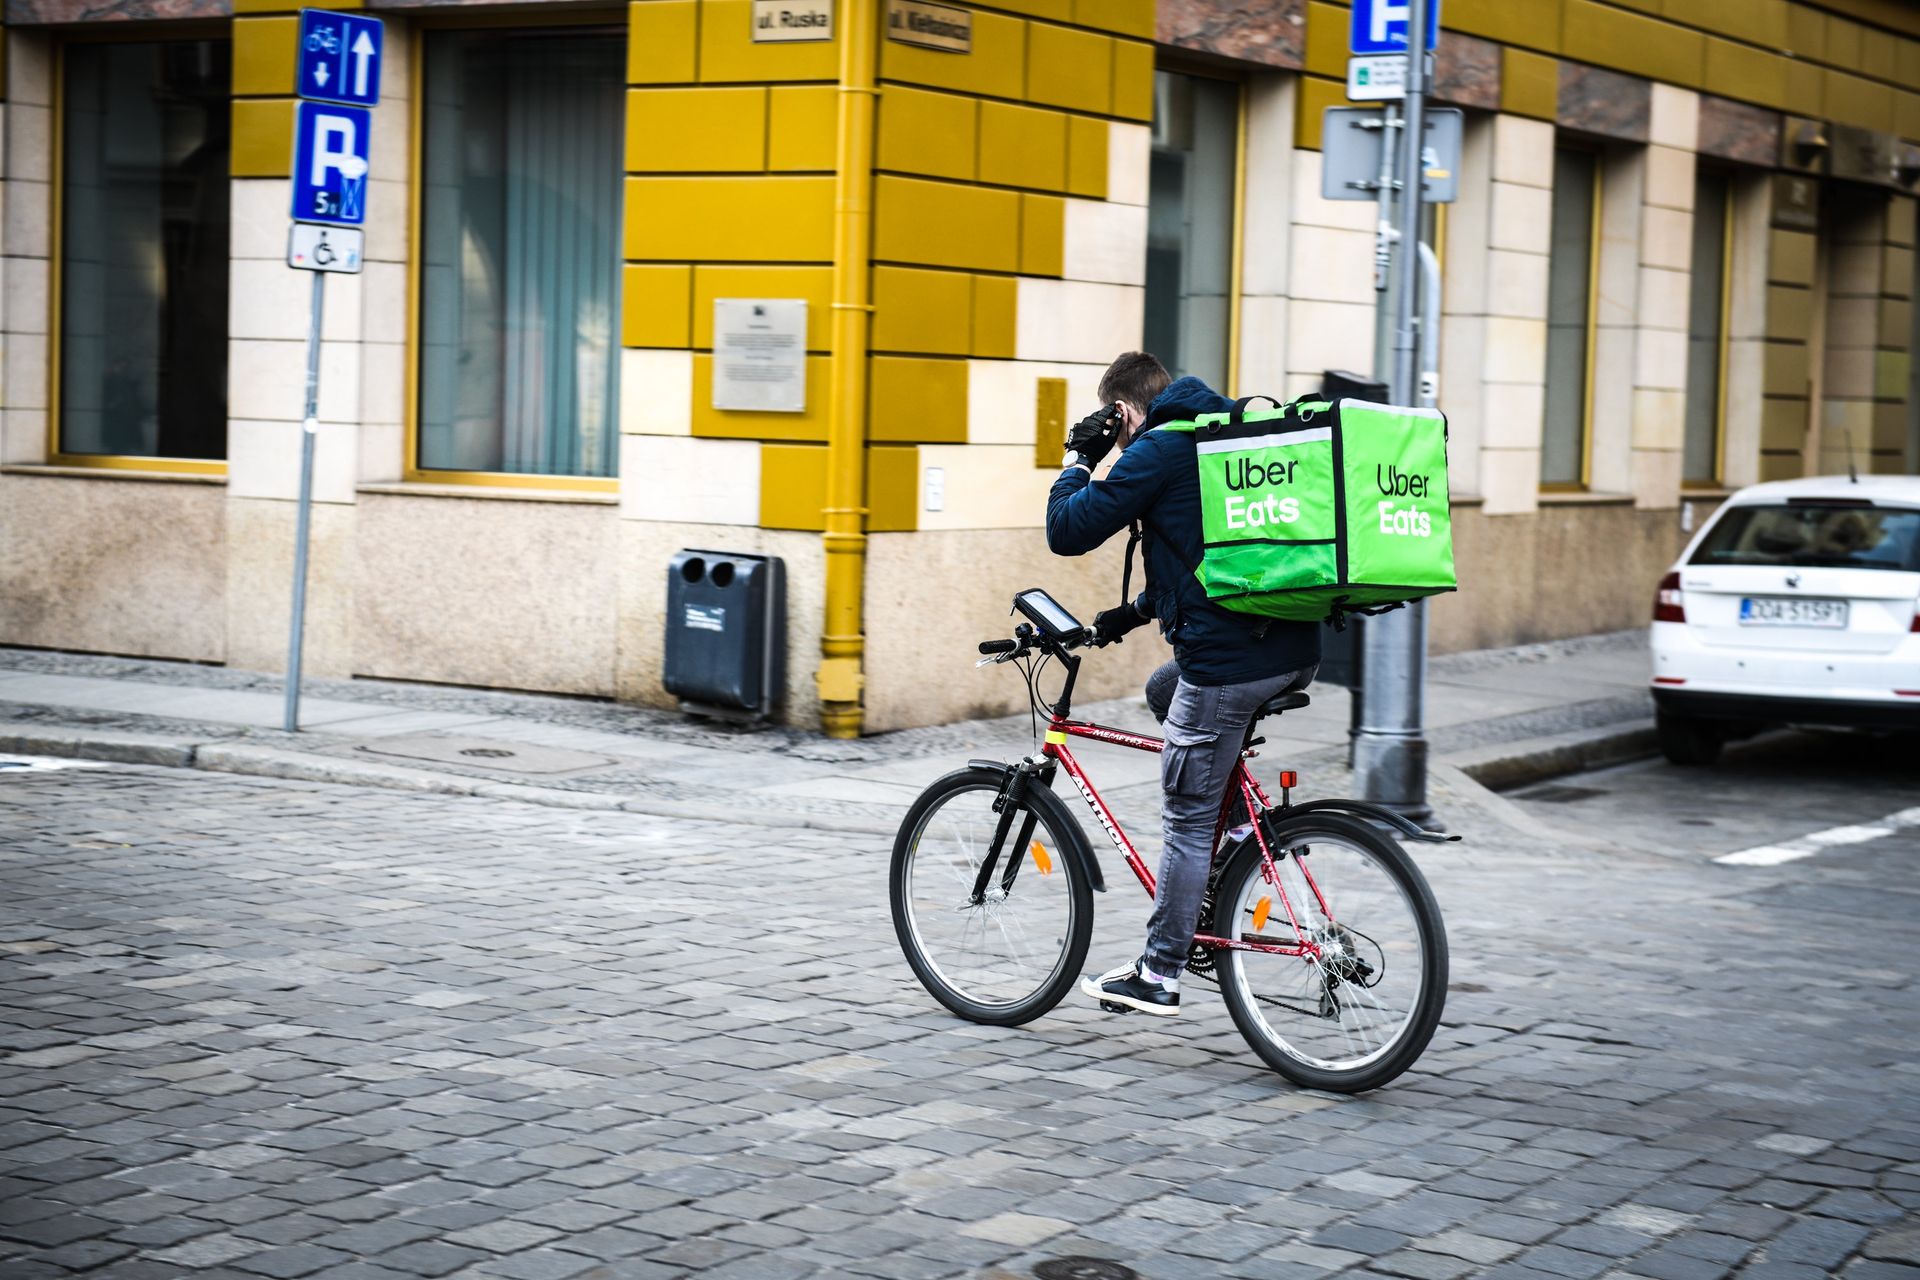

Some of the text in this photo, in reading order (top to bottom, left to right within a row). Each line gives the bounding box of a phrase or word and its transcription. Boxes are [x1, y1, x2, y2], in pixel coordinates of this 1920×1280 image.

[757, 10, 828, 29] ul. Ruska
[311, 114, 356, 187] P
[1225, 457, 1299, 491] Uber
[1377, 463, 1430, 498] Uber
[1225, 494, 1300, 529] Eats
[1378, 501, 1431, 537] Eats
[1093, 729, 1144, 746] MEMPHIS
[1071, 773, 1131, 858] AUTHOR
